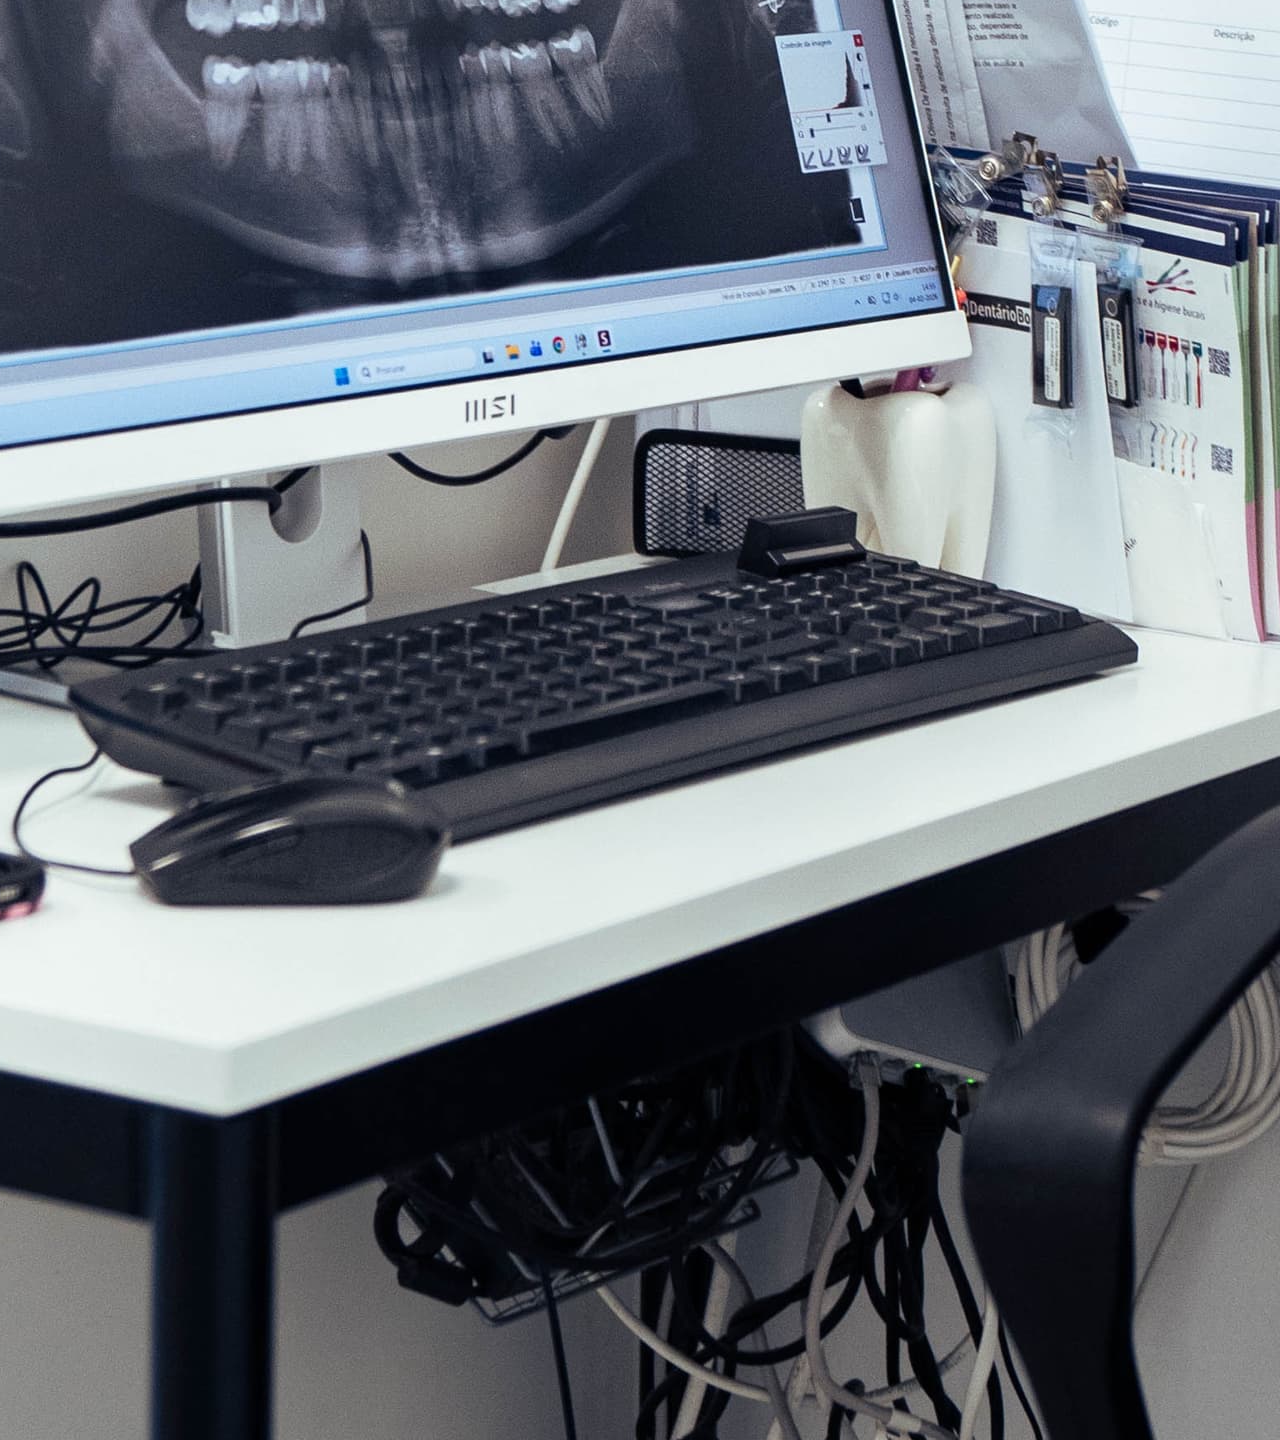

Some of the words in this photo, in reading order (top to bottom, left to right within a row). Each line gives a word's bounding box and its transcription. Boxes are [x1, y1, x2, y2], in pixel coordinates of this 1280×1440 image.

[1213, 27, 1256, 43] Descrição
[915, 62, 927, 93] Almeida
[927, 107, 936, 137] Oliveira
[969, 299, 1017, 322] Dentário
[1154, 298, 1181, 314] higiene
